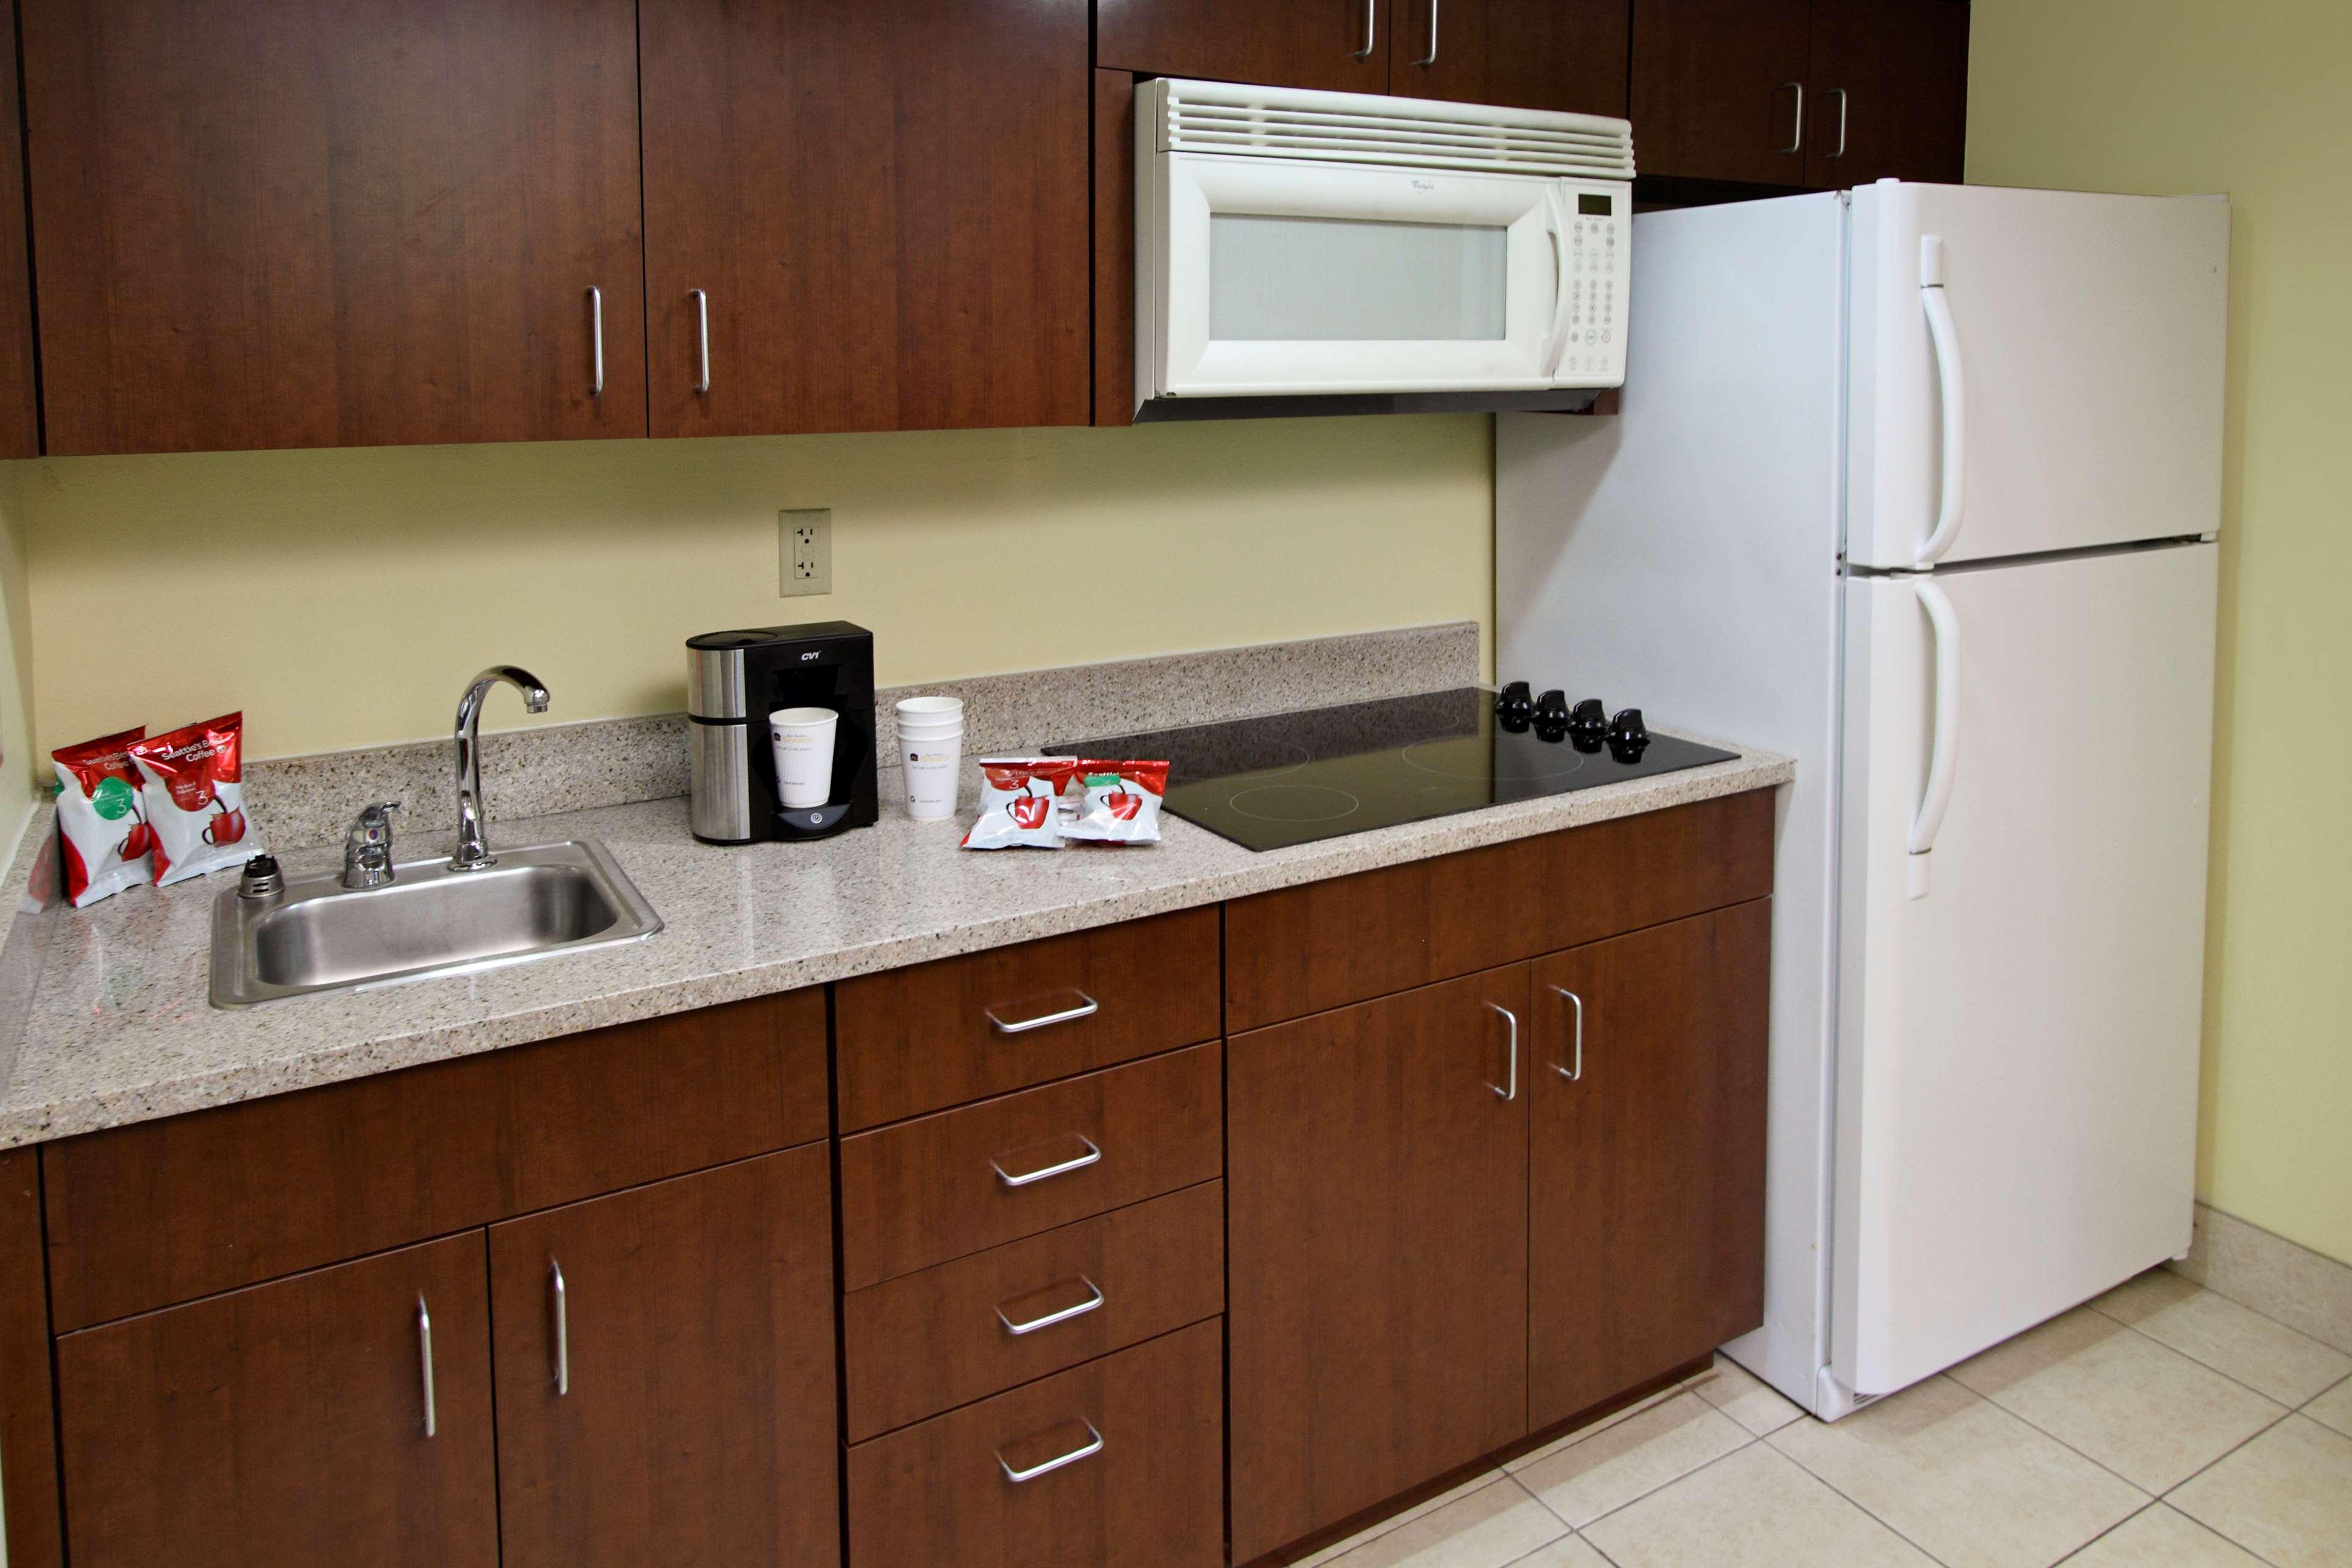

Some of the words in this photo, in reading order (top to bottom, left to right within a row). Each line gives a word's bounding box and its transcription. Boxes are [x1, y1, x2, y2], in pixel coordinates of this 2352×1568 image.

[161, 742, 202, 760] Seattle's
[186, 749, 216, 762] Coffee
[196, 790, 208, 805] 3
[116, 798, 127, 813] 3
